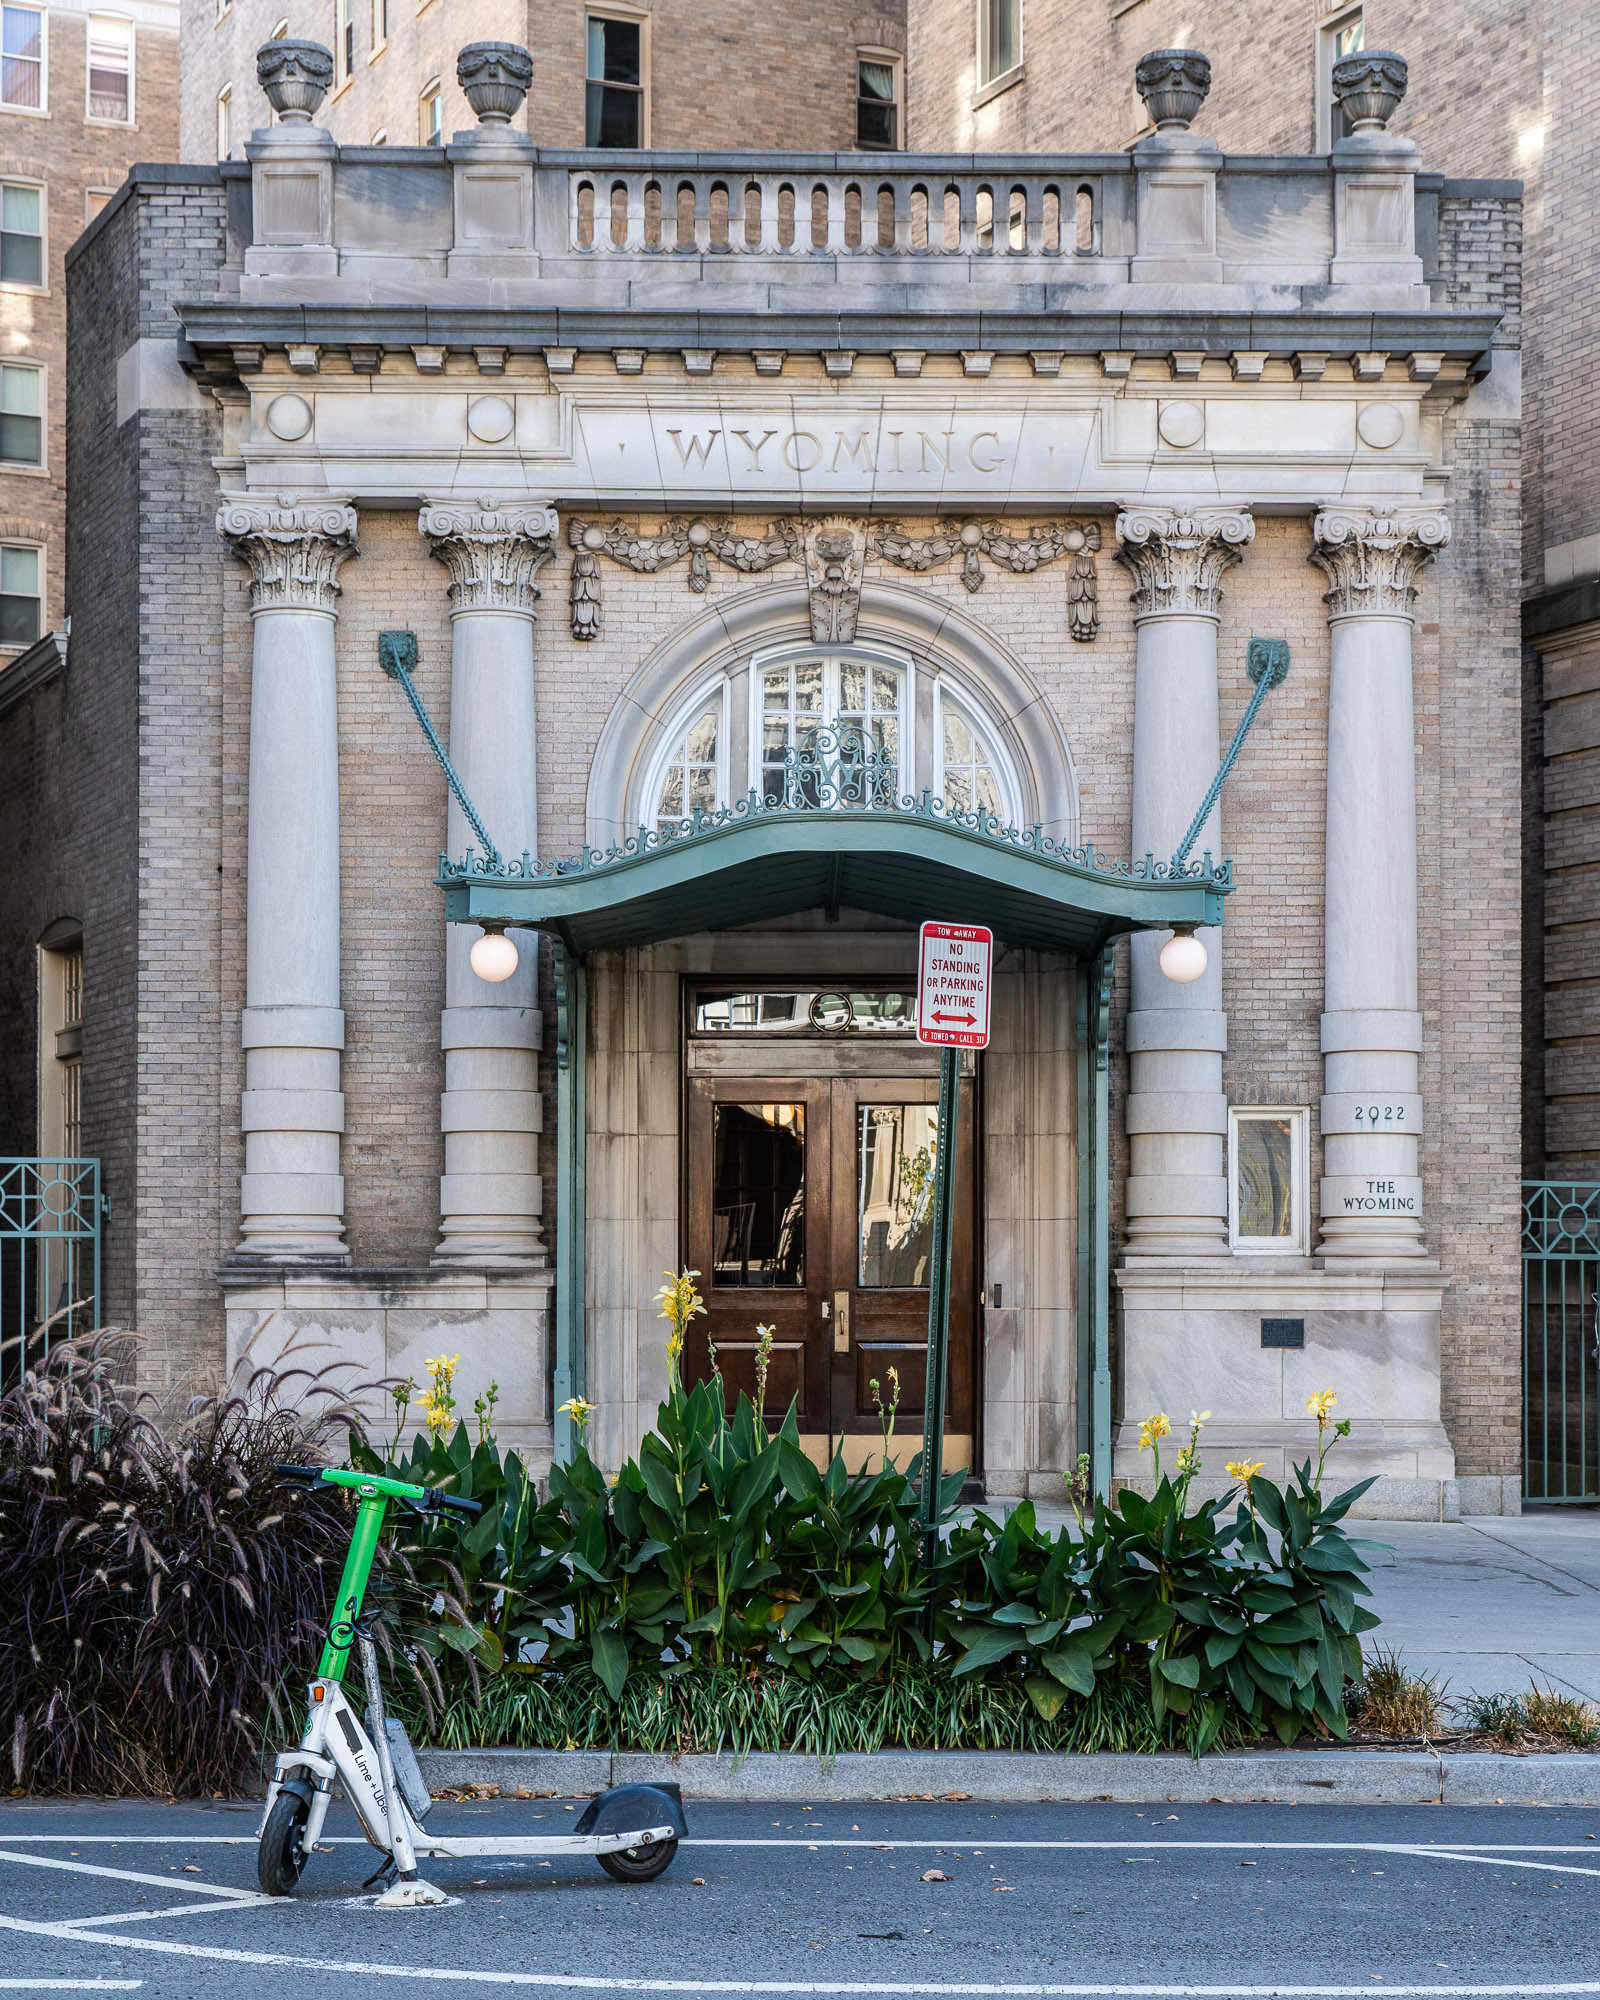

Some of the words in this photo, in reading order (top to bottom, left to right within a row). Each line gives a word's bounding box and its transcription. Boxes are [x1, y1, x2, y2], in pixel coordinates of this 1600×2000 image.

[666, 429, 1006, 473] WYOMING
[937, 927, 951, 936] TOW
[958, 929, 977, 939] AWAY
[949, 943, 964, 956] NO
[931, 958, 981, 974] STANDING
[926, 977, 938, 988] OR
[940, 977, 984, 992] PARKING
[933, 993, 976, 1008] ANYTIME
[922, 1031, 928, 1039] IF
[931, 1032, 949, 1041] TOWED
[959, 1034, 973, 1044] CALL
[976, 1035, 985, 1044] 311
[1355, 1106, 1405, 1120] 2022
[1366, 1181, 1395, 1193] THE
[1343, 1197, 1414, 1210] WYOMING
[354, 1754, 372, 1782] Lime
[373, 1789, 388, 1817] Ube
